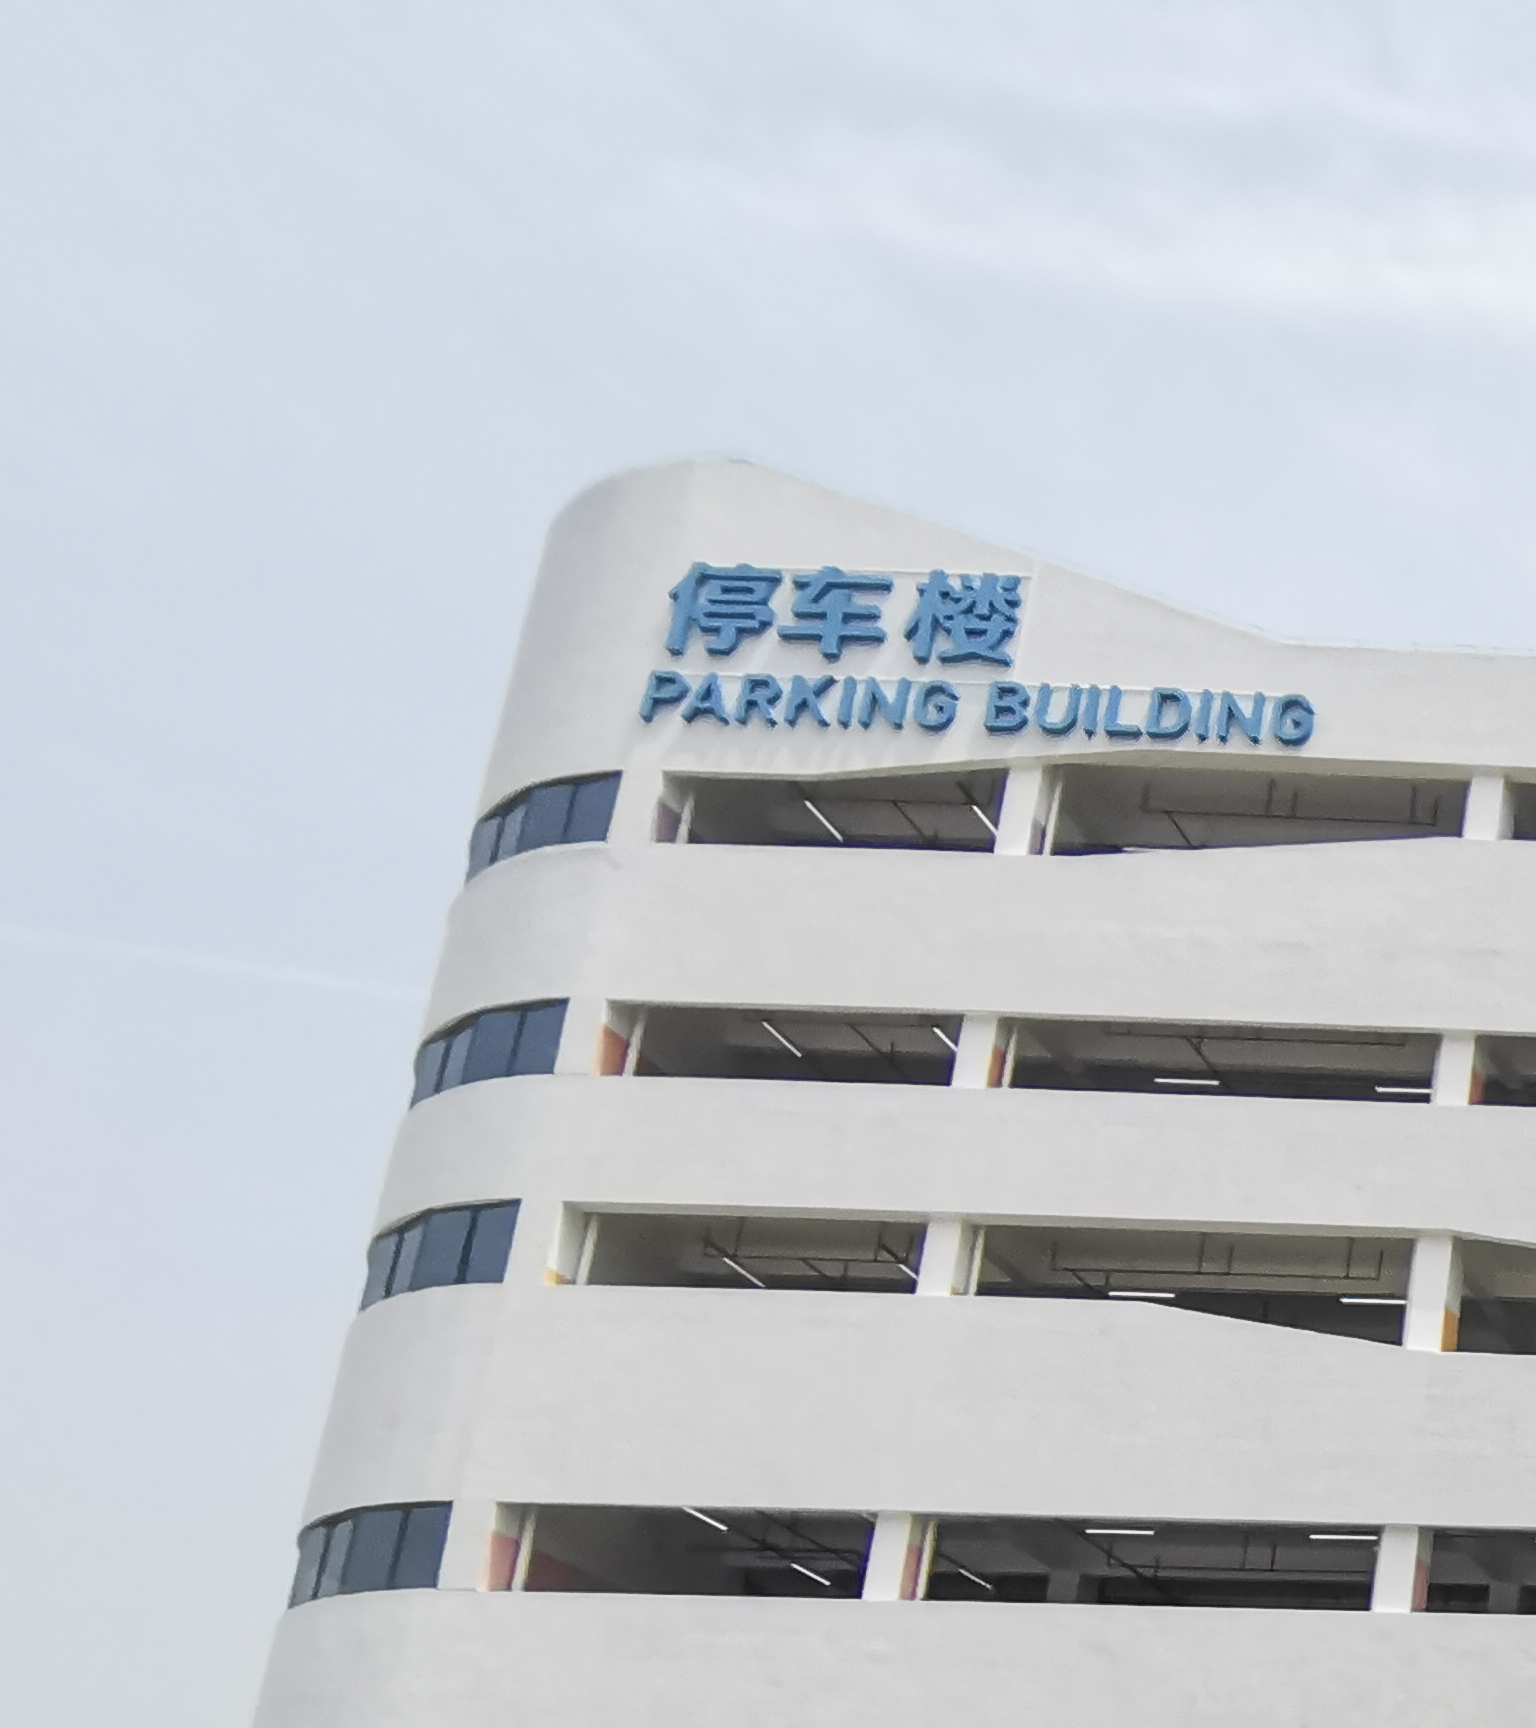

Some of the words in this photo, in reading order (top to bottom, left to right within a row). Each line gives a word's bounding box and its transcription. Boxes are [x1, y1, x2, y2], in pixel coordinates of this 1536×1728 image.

[665, 562, 1022, 667] 停车楼
[638, 670, 960, 733] PARKING
[984, 681, 1315, 746] BUILDING
